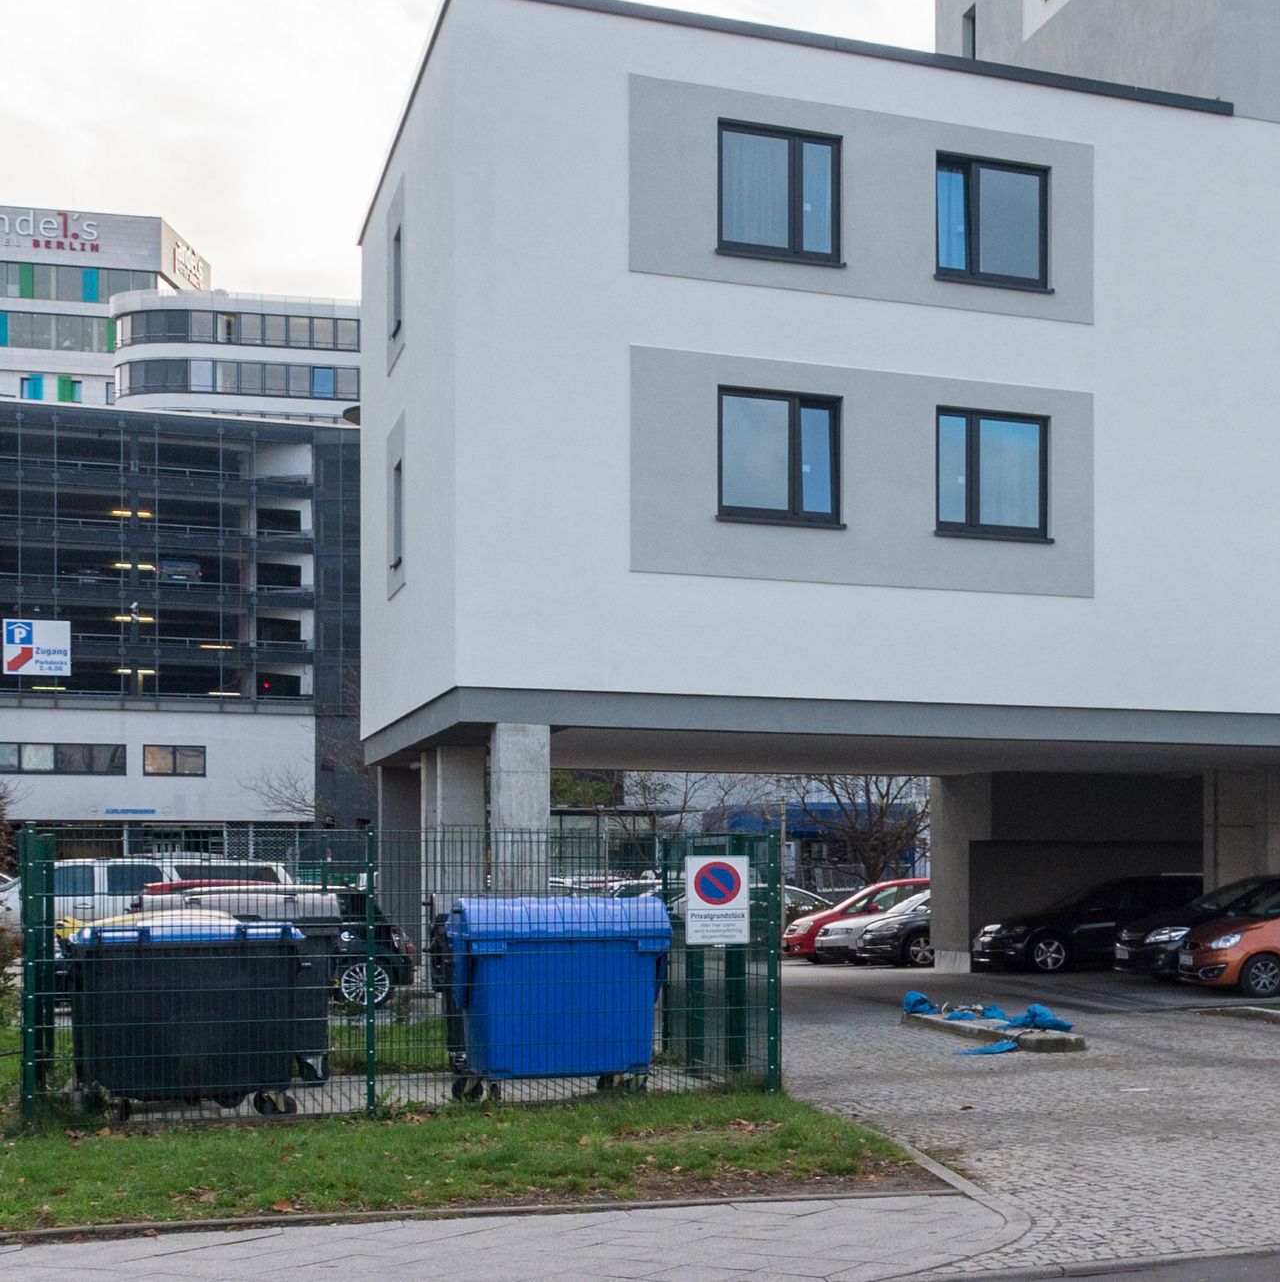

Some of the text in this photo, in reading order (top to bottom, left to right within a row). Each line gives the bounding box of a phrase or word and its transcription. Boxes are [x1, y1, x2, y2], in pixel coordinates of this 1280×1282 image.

[32, 239, 99, 253] BERLIN
[13, 628, 27, 644] P
[35, 647, 68, 657] Zugang
